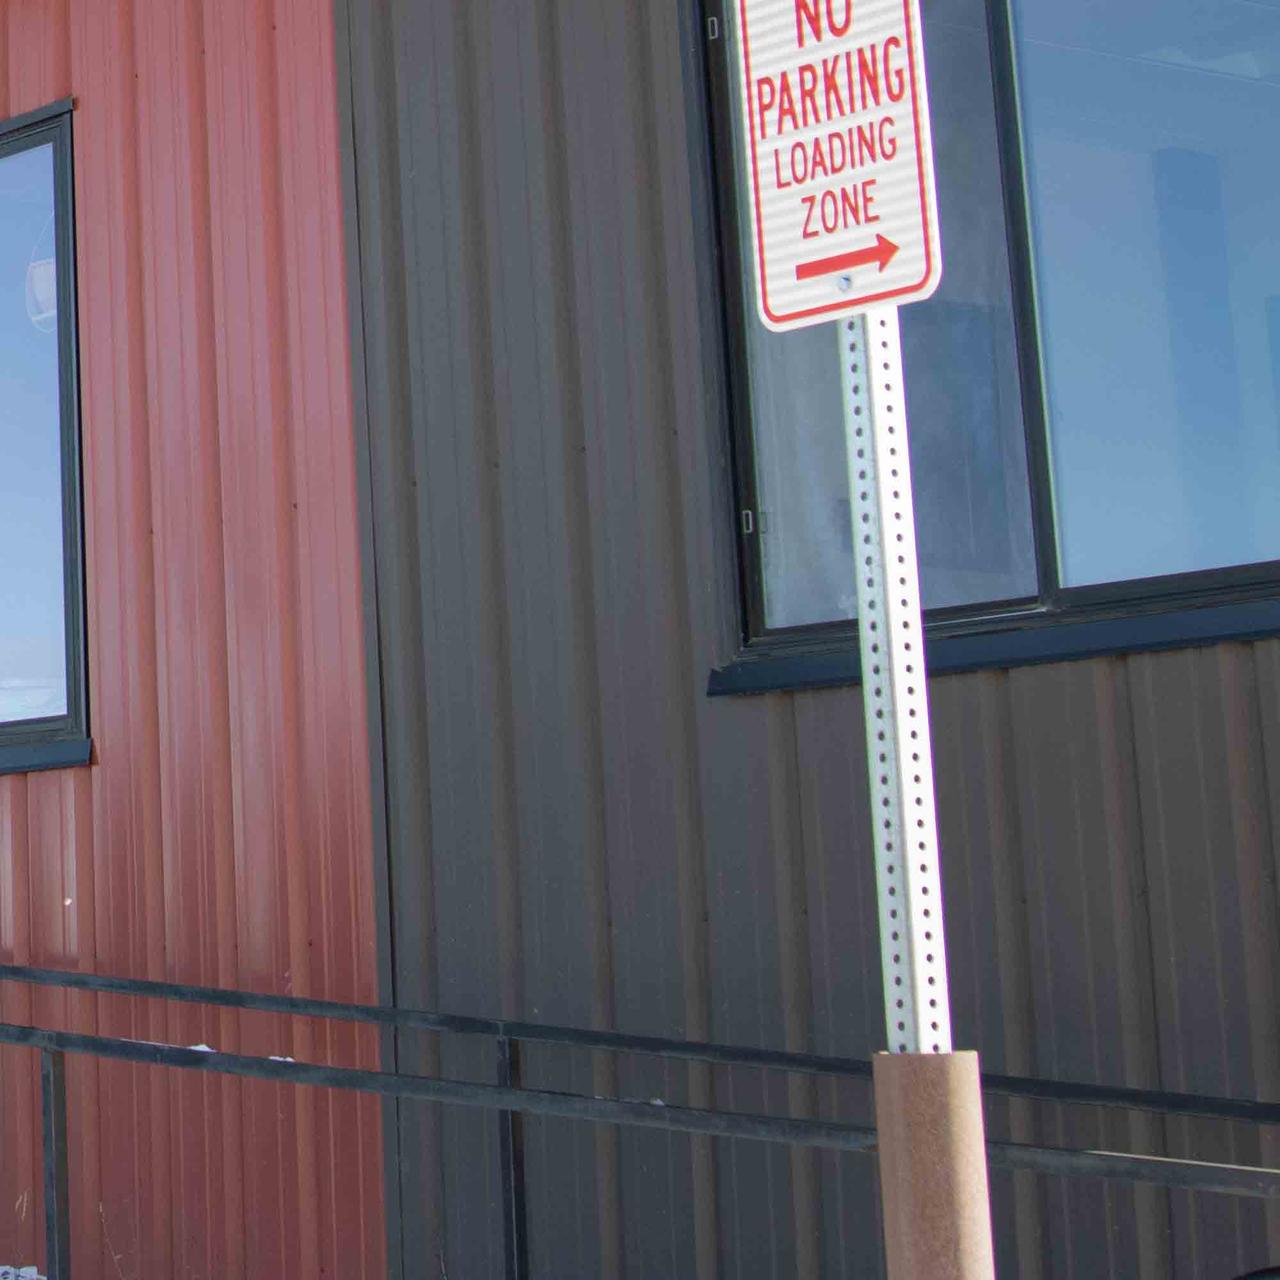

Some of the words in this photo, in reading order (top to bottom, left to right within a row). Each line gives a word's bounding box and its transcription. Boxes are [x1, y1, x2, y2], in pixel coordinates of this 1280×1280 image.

[757, 36, 905, 140] PARKING
[775, 116, 897, 189] LOADING
[801, 178, 881, 240] ZONE
